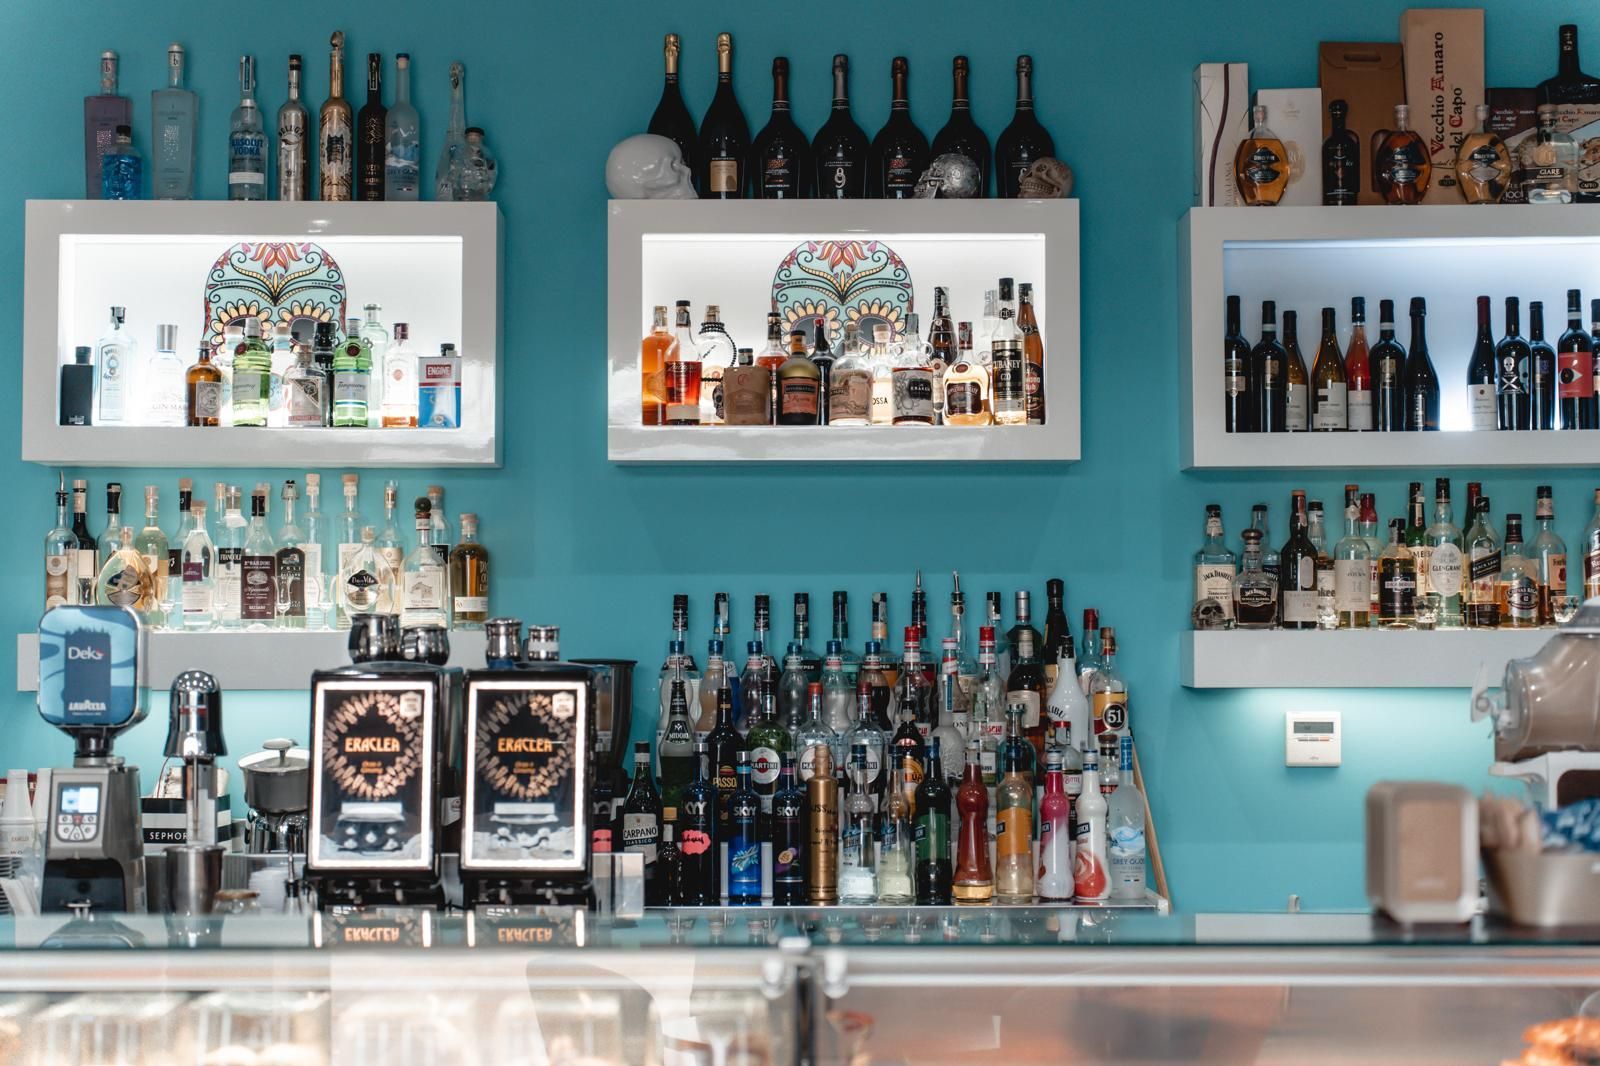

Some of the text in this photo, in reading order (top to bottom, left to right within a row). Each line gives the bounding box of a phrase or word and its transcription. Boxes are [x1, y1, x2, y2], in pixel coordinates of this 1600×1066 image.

[1430, 31, 1445, 157] Vecchio Amaro
[1449, 86, 1466, 128] Capo
[233, 146, 261, 156] VODKA
[427, 366, 450, 376] ENGINE
[1202, 573, 1215, 583] JACK
[68, 699, 107, 711] LAVAZZA
[1107, 709, 1122, 724] 51
[344, 737, 401, 753] ERACLEA
[497, 737, 553, 753] ERACLEA
[733, 806, 757, 817] SKYY
[776, 806, 800, 817] SKYY
[623, 826, 658, 839] CARPANO
